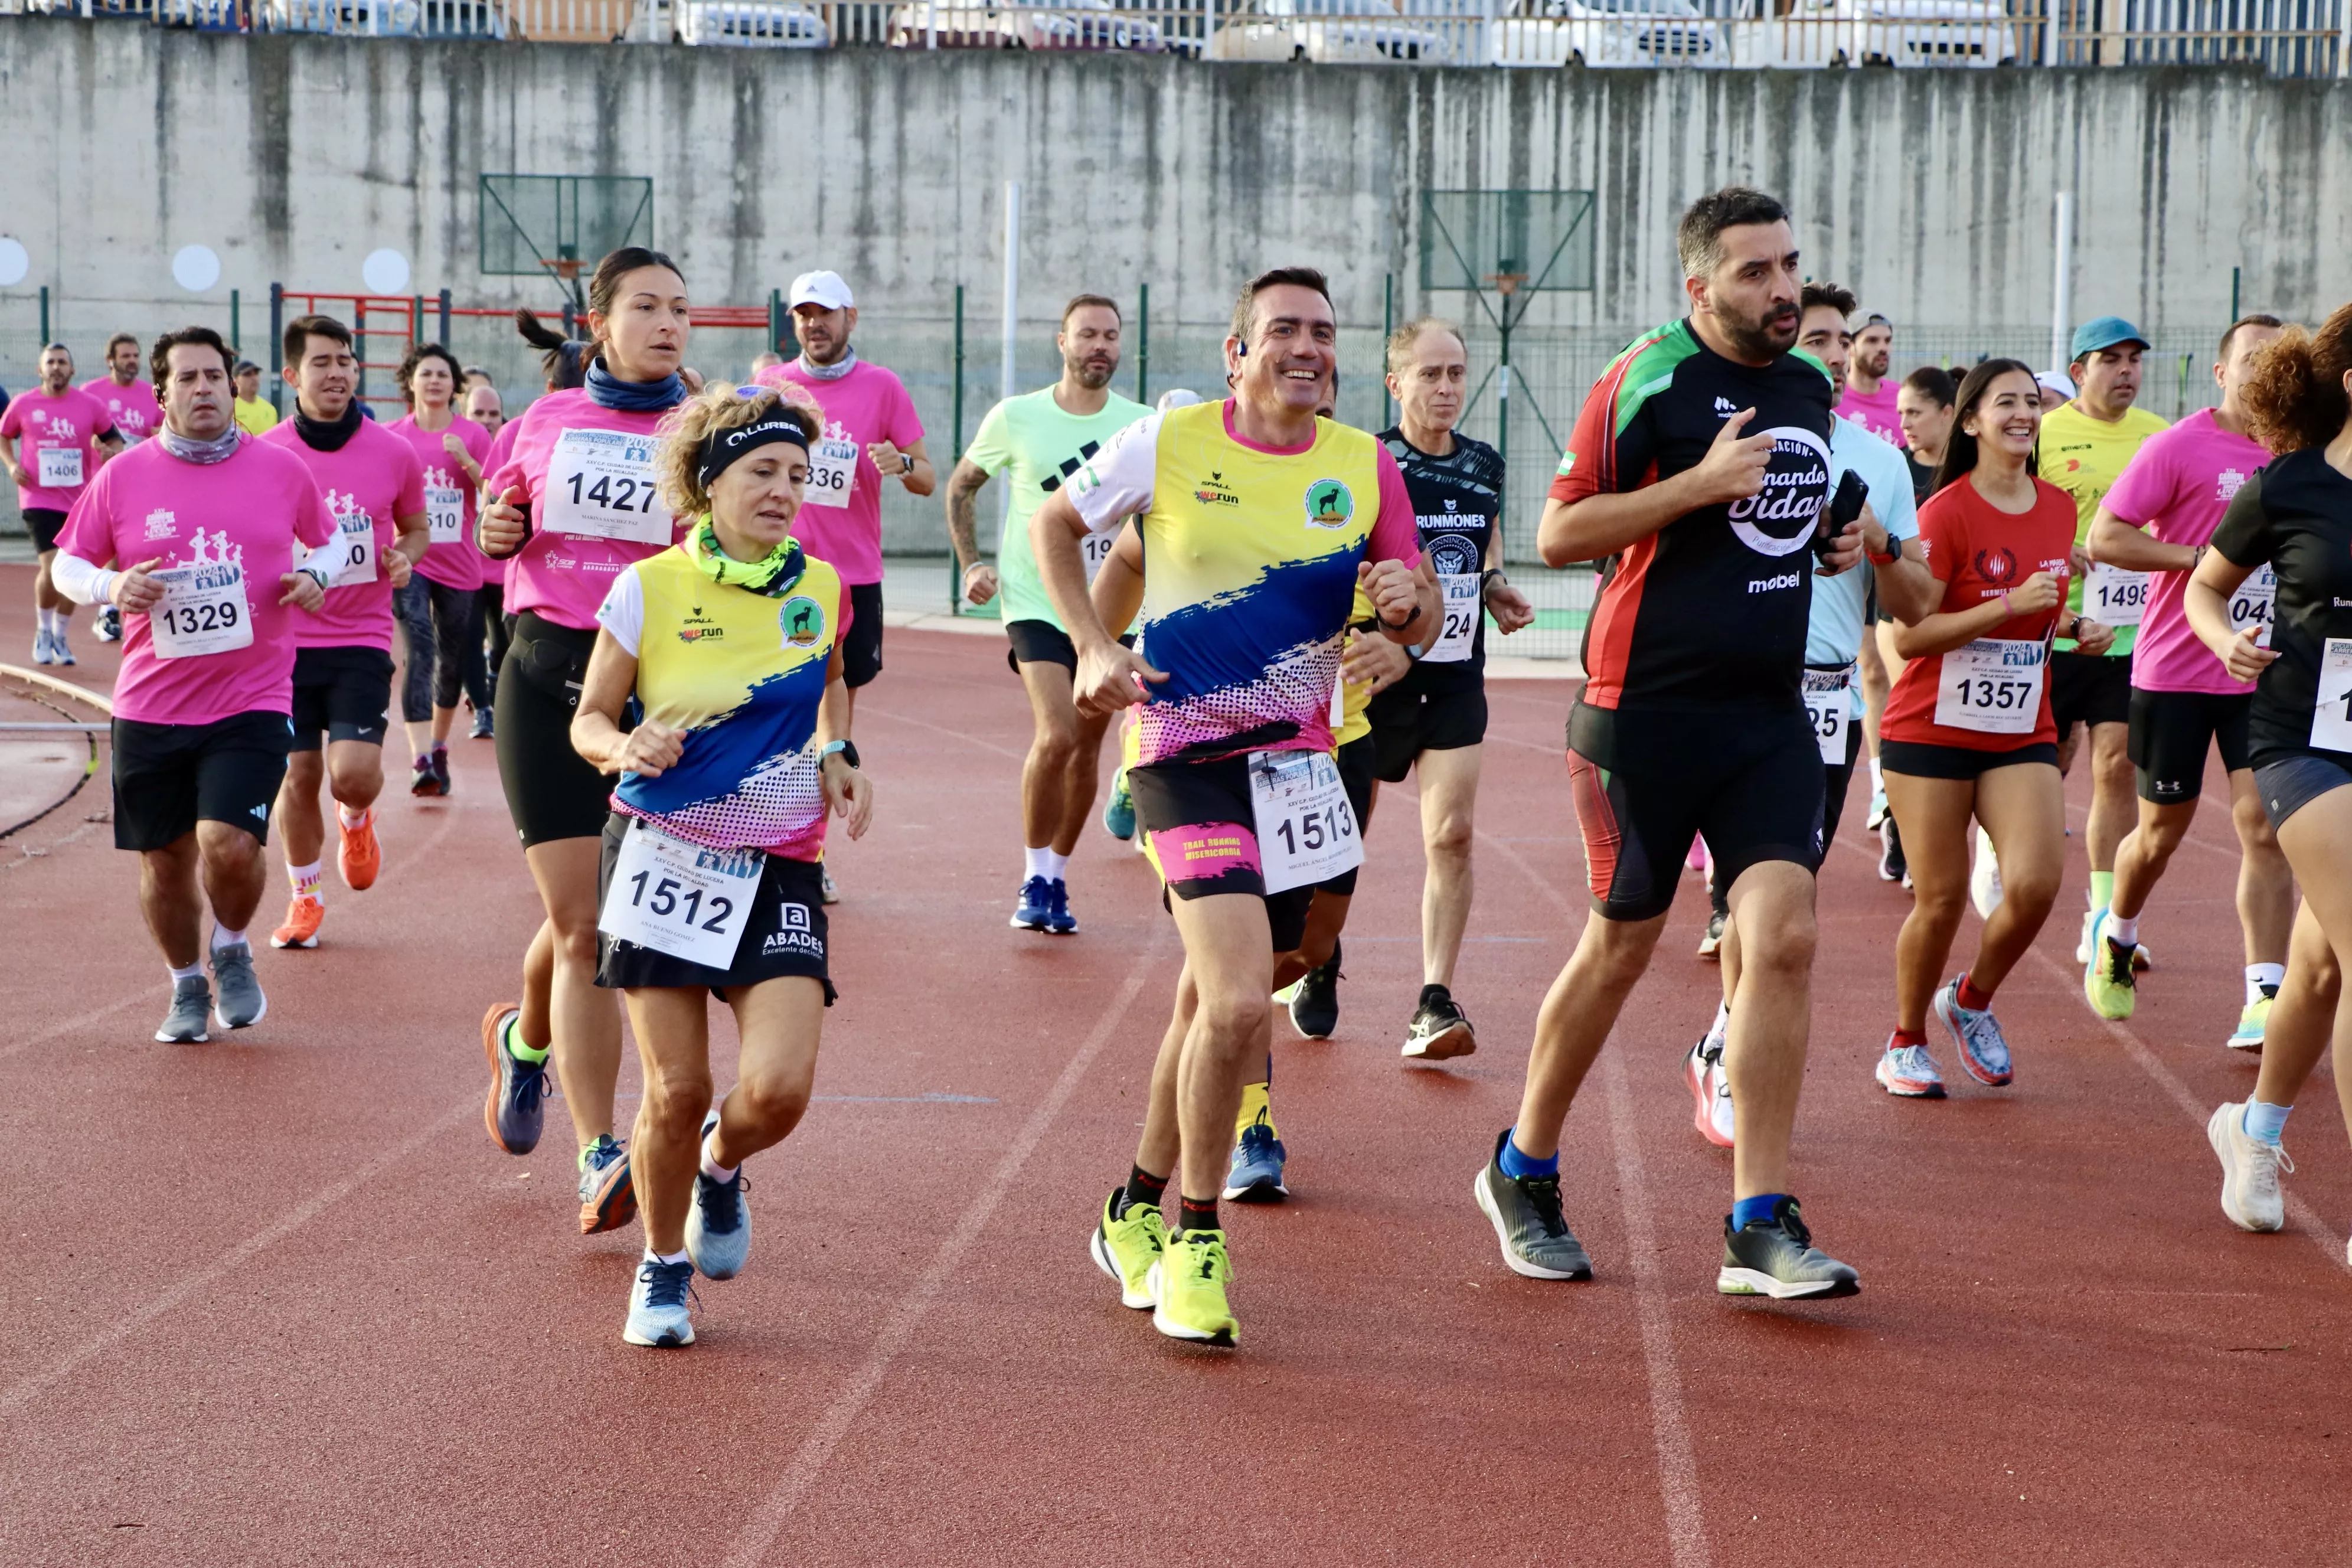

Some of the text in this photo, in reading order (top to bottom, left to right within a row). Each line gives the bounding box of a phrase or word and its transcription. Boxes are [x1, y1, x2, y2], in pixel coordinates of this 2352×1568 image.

[746, 422, 805, 436] LURBEL
[47, 465, 78, 476] 1406
[567, 472, 656, 513] 1427
[1416, 514, 1486, 528] RUNMONES
[164, 602, 237, 635] 1329
[2233, 598, 2275, 624] 04
[1444, 613, 1470, 639] 24
[1957, 679, 2032, 709] 1357
[1256, 775, 1285, 788] CARRRAS
[1277, 800, 1352, 855] 1513
[1183, 837, 1241, 851] TRAIL RUNNING
[1185, 848, 1241, 861] MISERICORDIA
[667, 860, 676, 868] C.P.
[677, 864, 695, 876] CIUDAD
[703, 875, 724, 884] LUCENA
[1288, 861, 1310, 870] MIGUEL
[682, 875, 709, 888] IGUALDAD
[631, 870, 734, 935] 1512
[763, 932, 824, 955] ABADES
[763, 946, 822, 961] Excelente decisión
